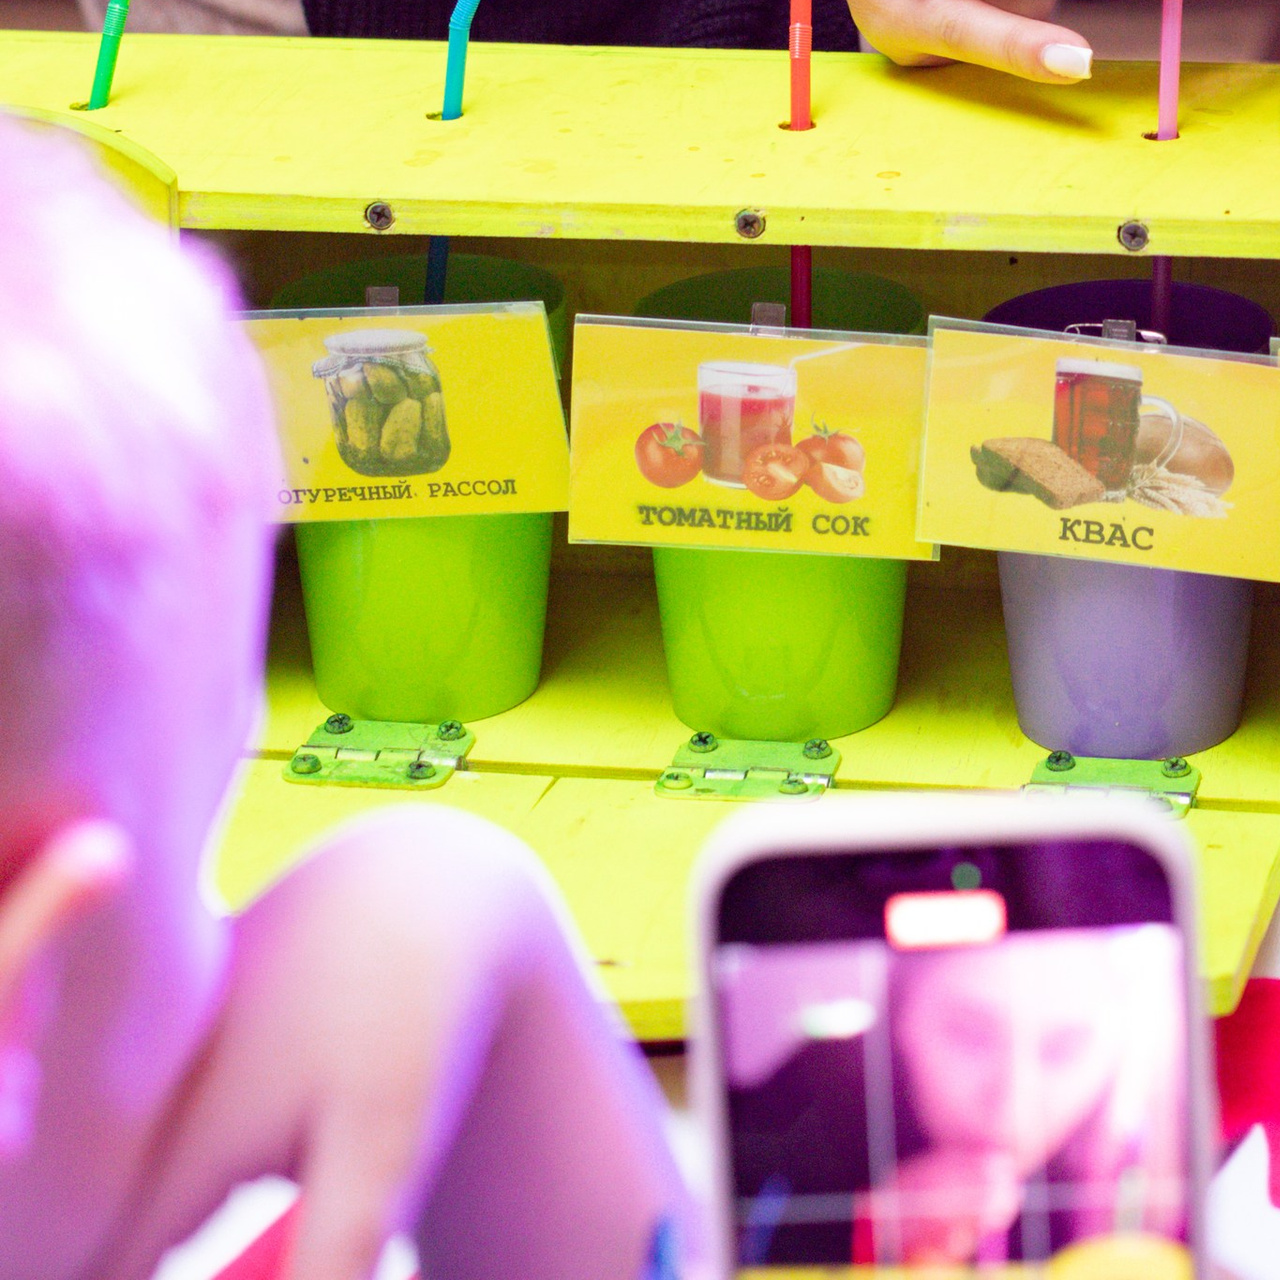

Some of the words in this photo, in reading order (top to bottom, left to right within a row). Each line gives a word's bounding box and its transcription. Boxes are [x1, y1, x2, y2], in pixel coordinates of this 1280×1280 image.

[277, 479, 413, 505] ОГУРЕЧНЫЙ
[428, 478, 518, 498] РАССОЛ
[637, 505, 793, 533] ТОМАТНЫЙ
[811, 513, 871, 537] СОК
[1058, 516, 1155, 551] КВАС
